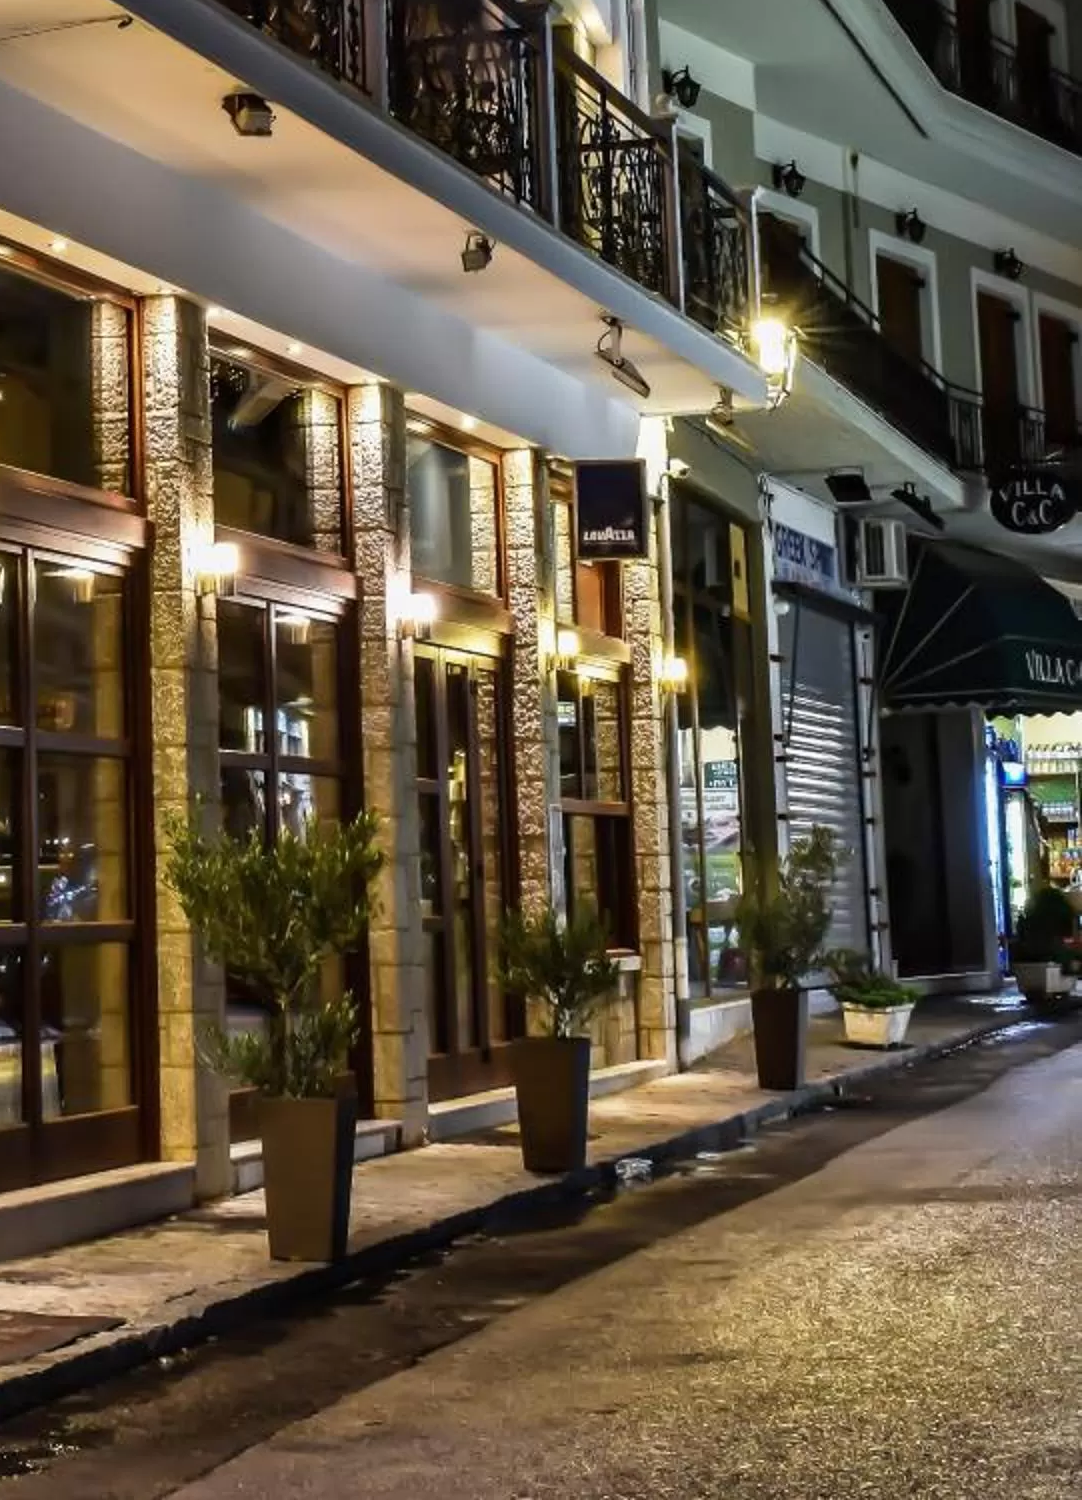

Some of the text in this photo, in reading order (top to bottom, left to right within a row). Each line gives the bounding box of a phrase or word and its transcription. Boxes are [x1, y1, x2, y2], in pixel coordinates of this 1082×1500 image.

[999, 478, 1066, 502] VILLA
[1012, 499, 1052, 527] C&C
[1025, 649, 1065, 685] VILLA
